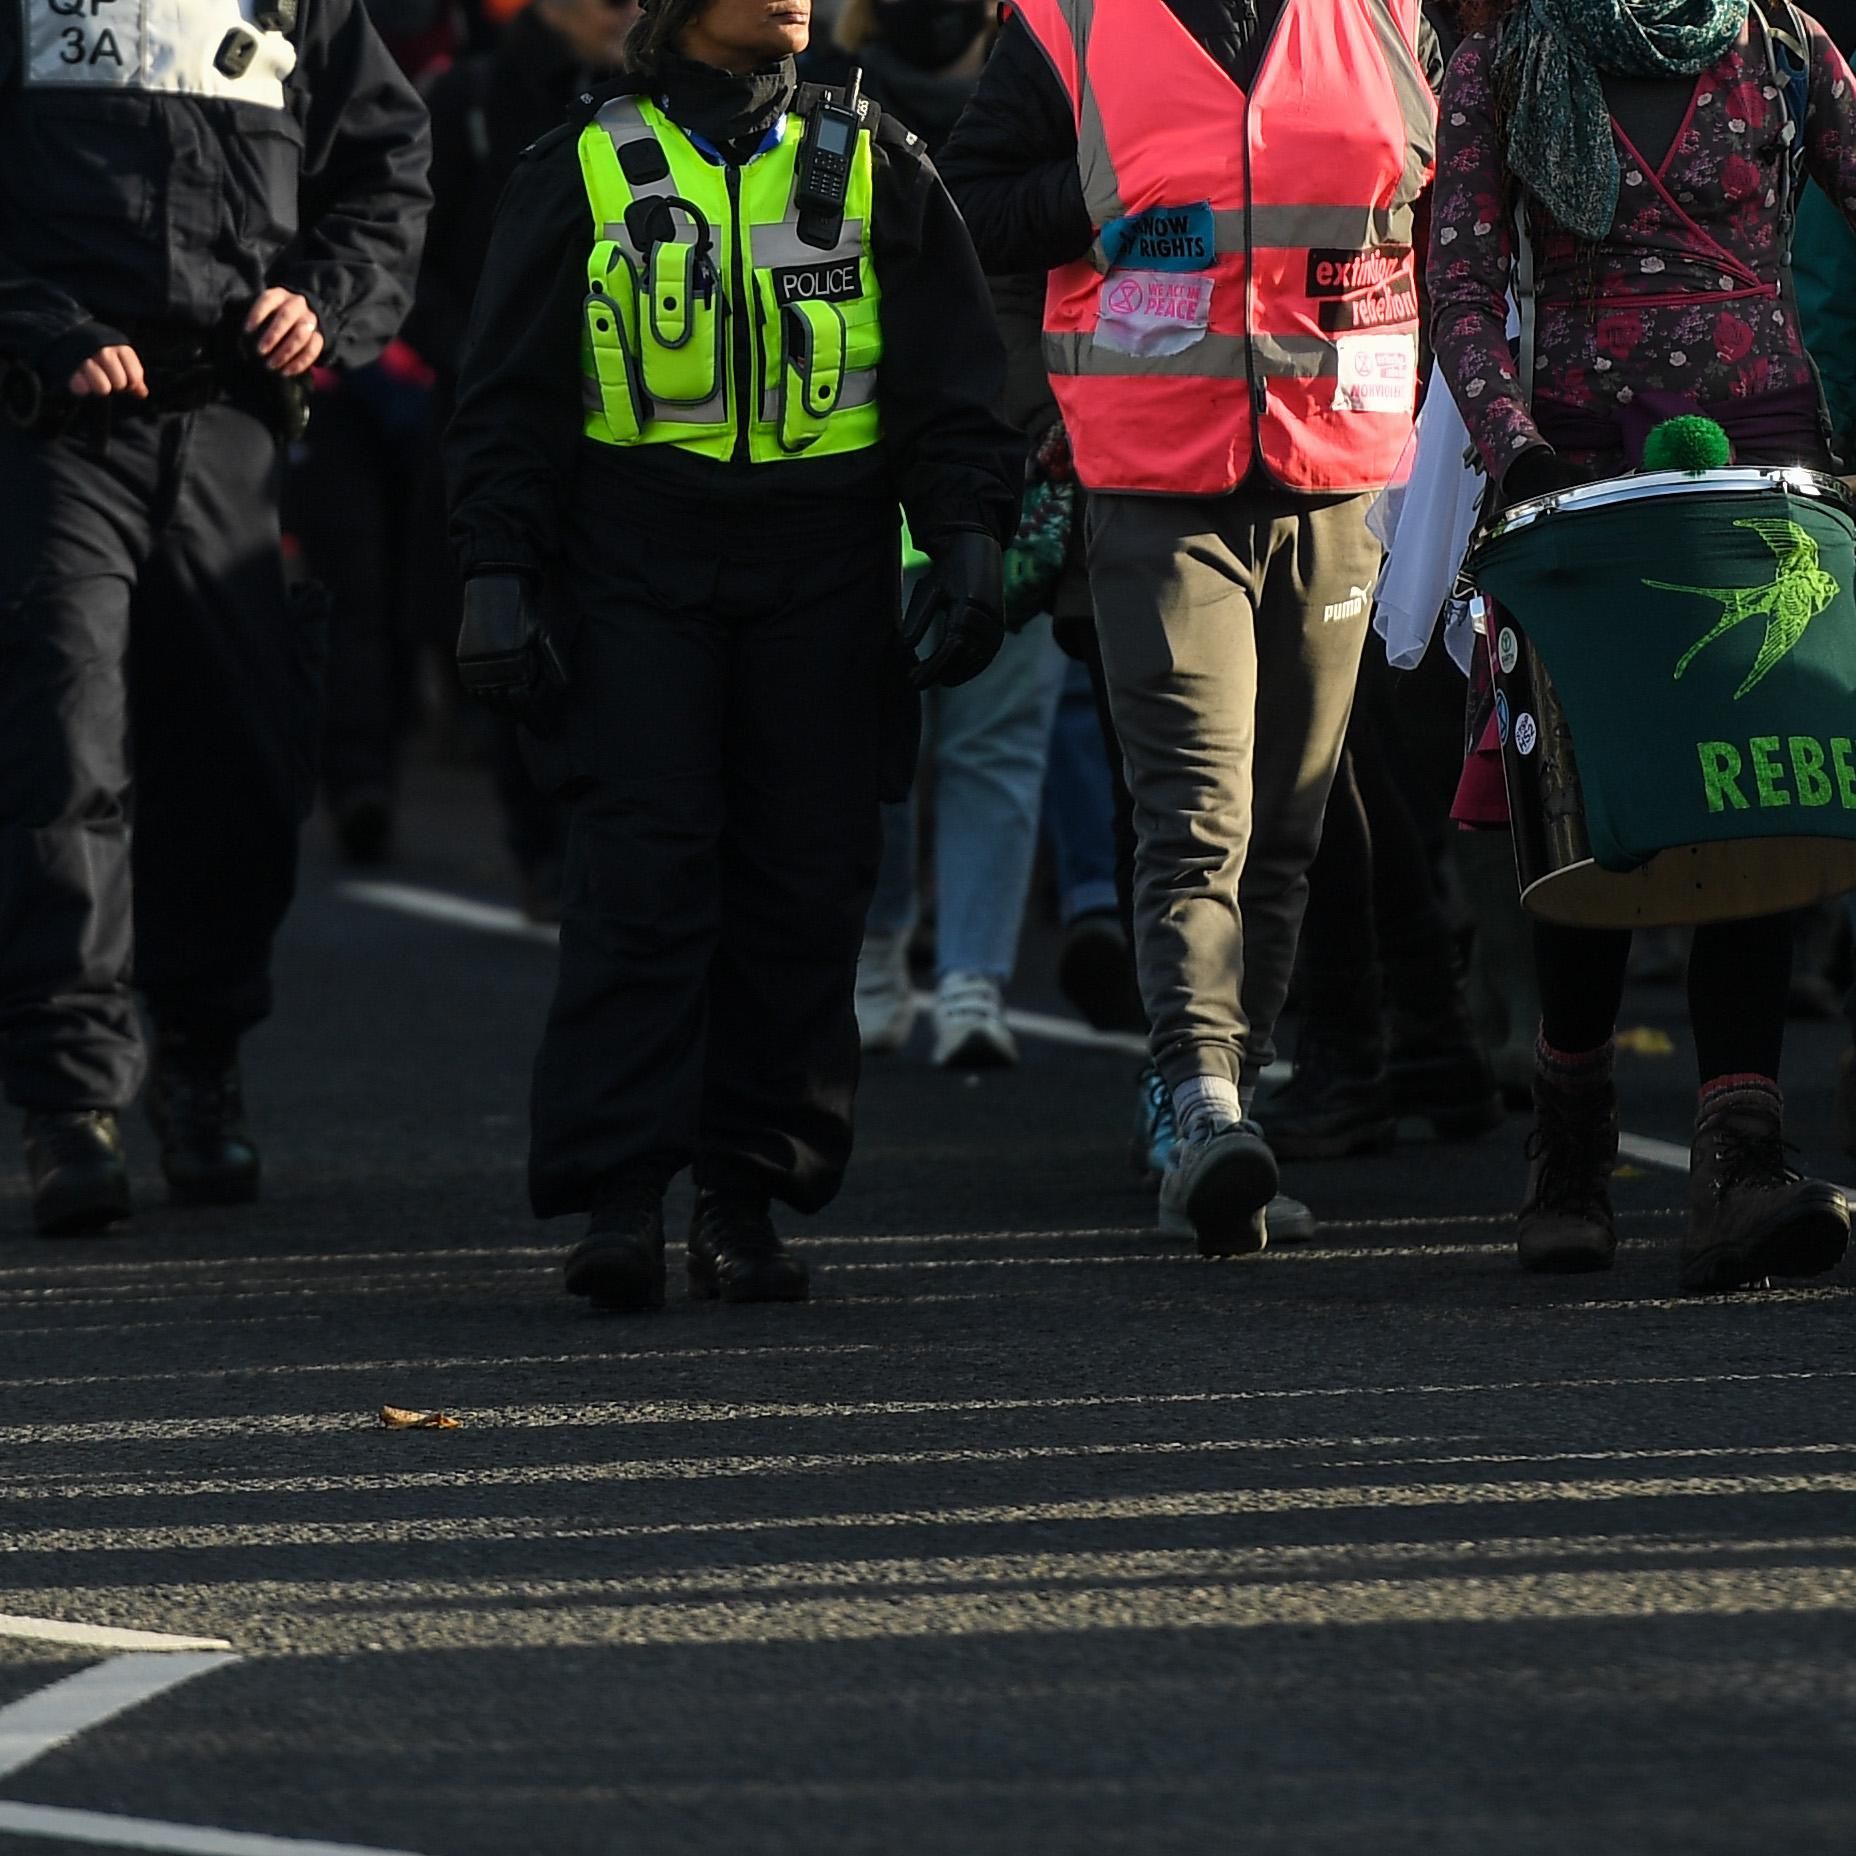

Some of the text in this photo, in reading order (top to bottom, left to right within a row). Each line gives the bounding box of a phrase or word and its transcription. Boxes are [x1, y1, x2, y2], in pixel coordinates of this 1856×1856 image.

[60, 27, 124, 67] 3A
[1139, 236, 1206, 258] RIGHTS
[782, 265, 857, 301] POLICE
[1148, 282, 1165, 297] WE
[1144, 297, 1198, 321] PEACE
